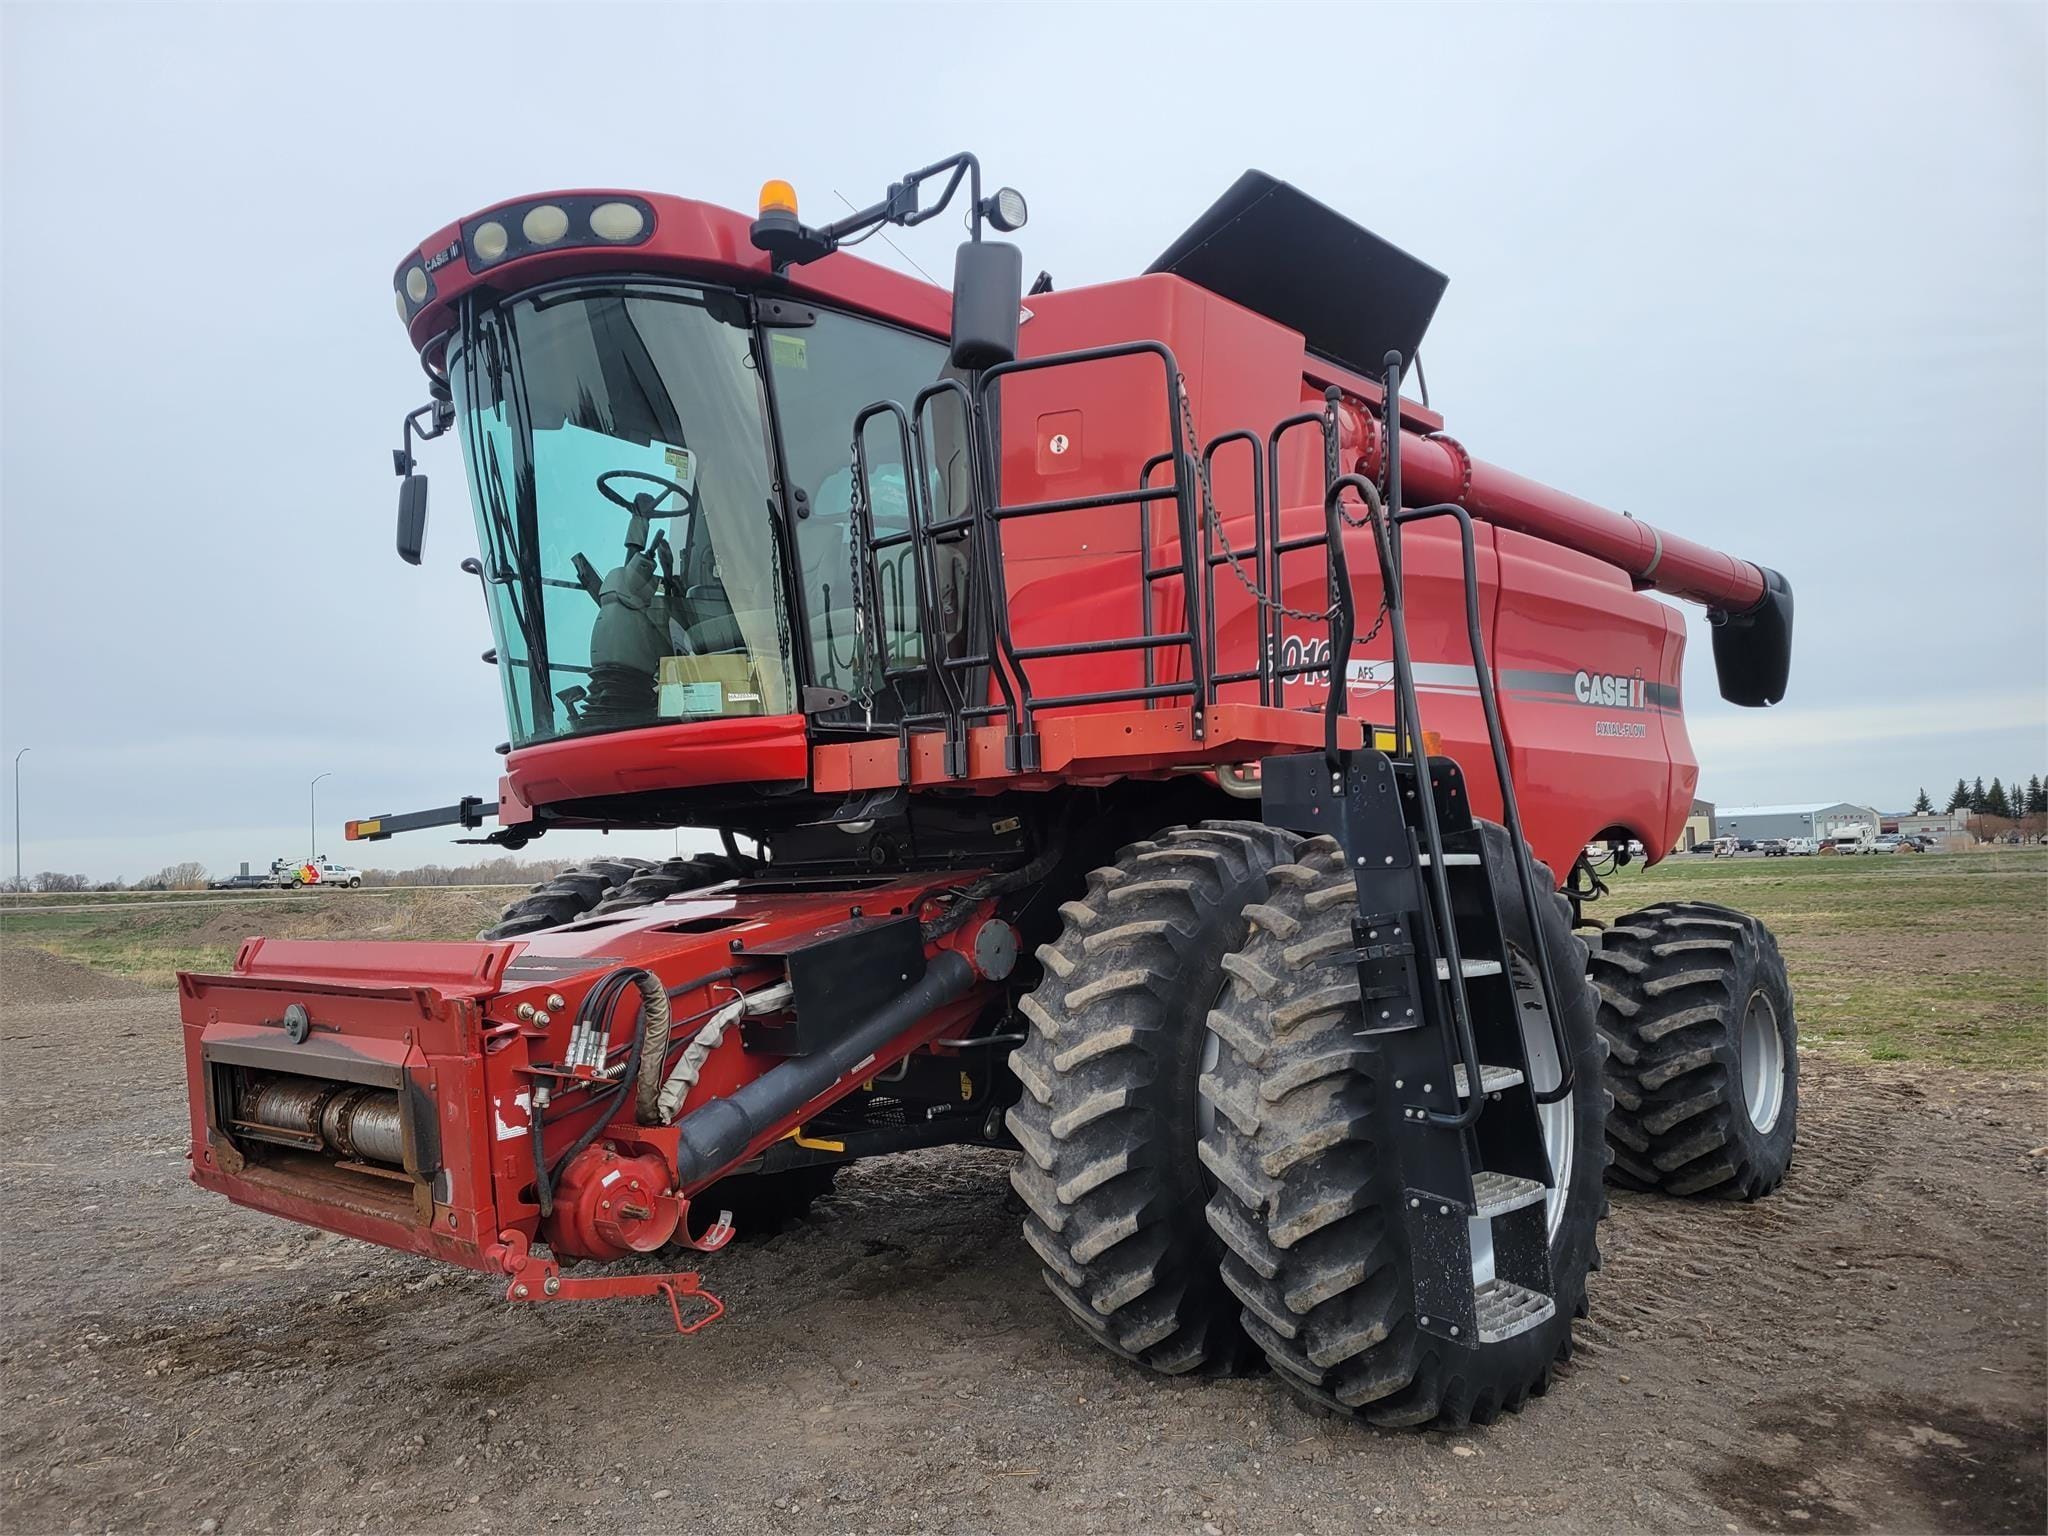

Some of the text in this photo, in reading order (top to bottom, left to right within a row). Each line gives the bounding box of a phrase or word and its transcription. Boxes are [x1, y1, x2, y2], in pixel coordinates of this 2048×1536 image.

[424, 250, 449, 272] CASE
[1256, 634, 1331, 687] 010
[1357, 666, 1374, 680] AFS
[1574, 671, 1628, 707] CASE
[1595, 721, 1646, 738] AXIAL-FLOW
